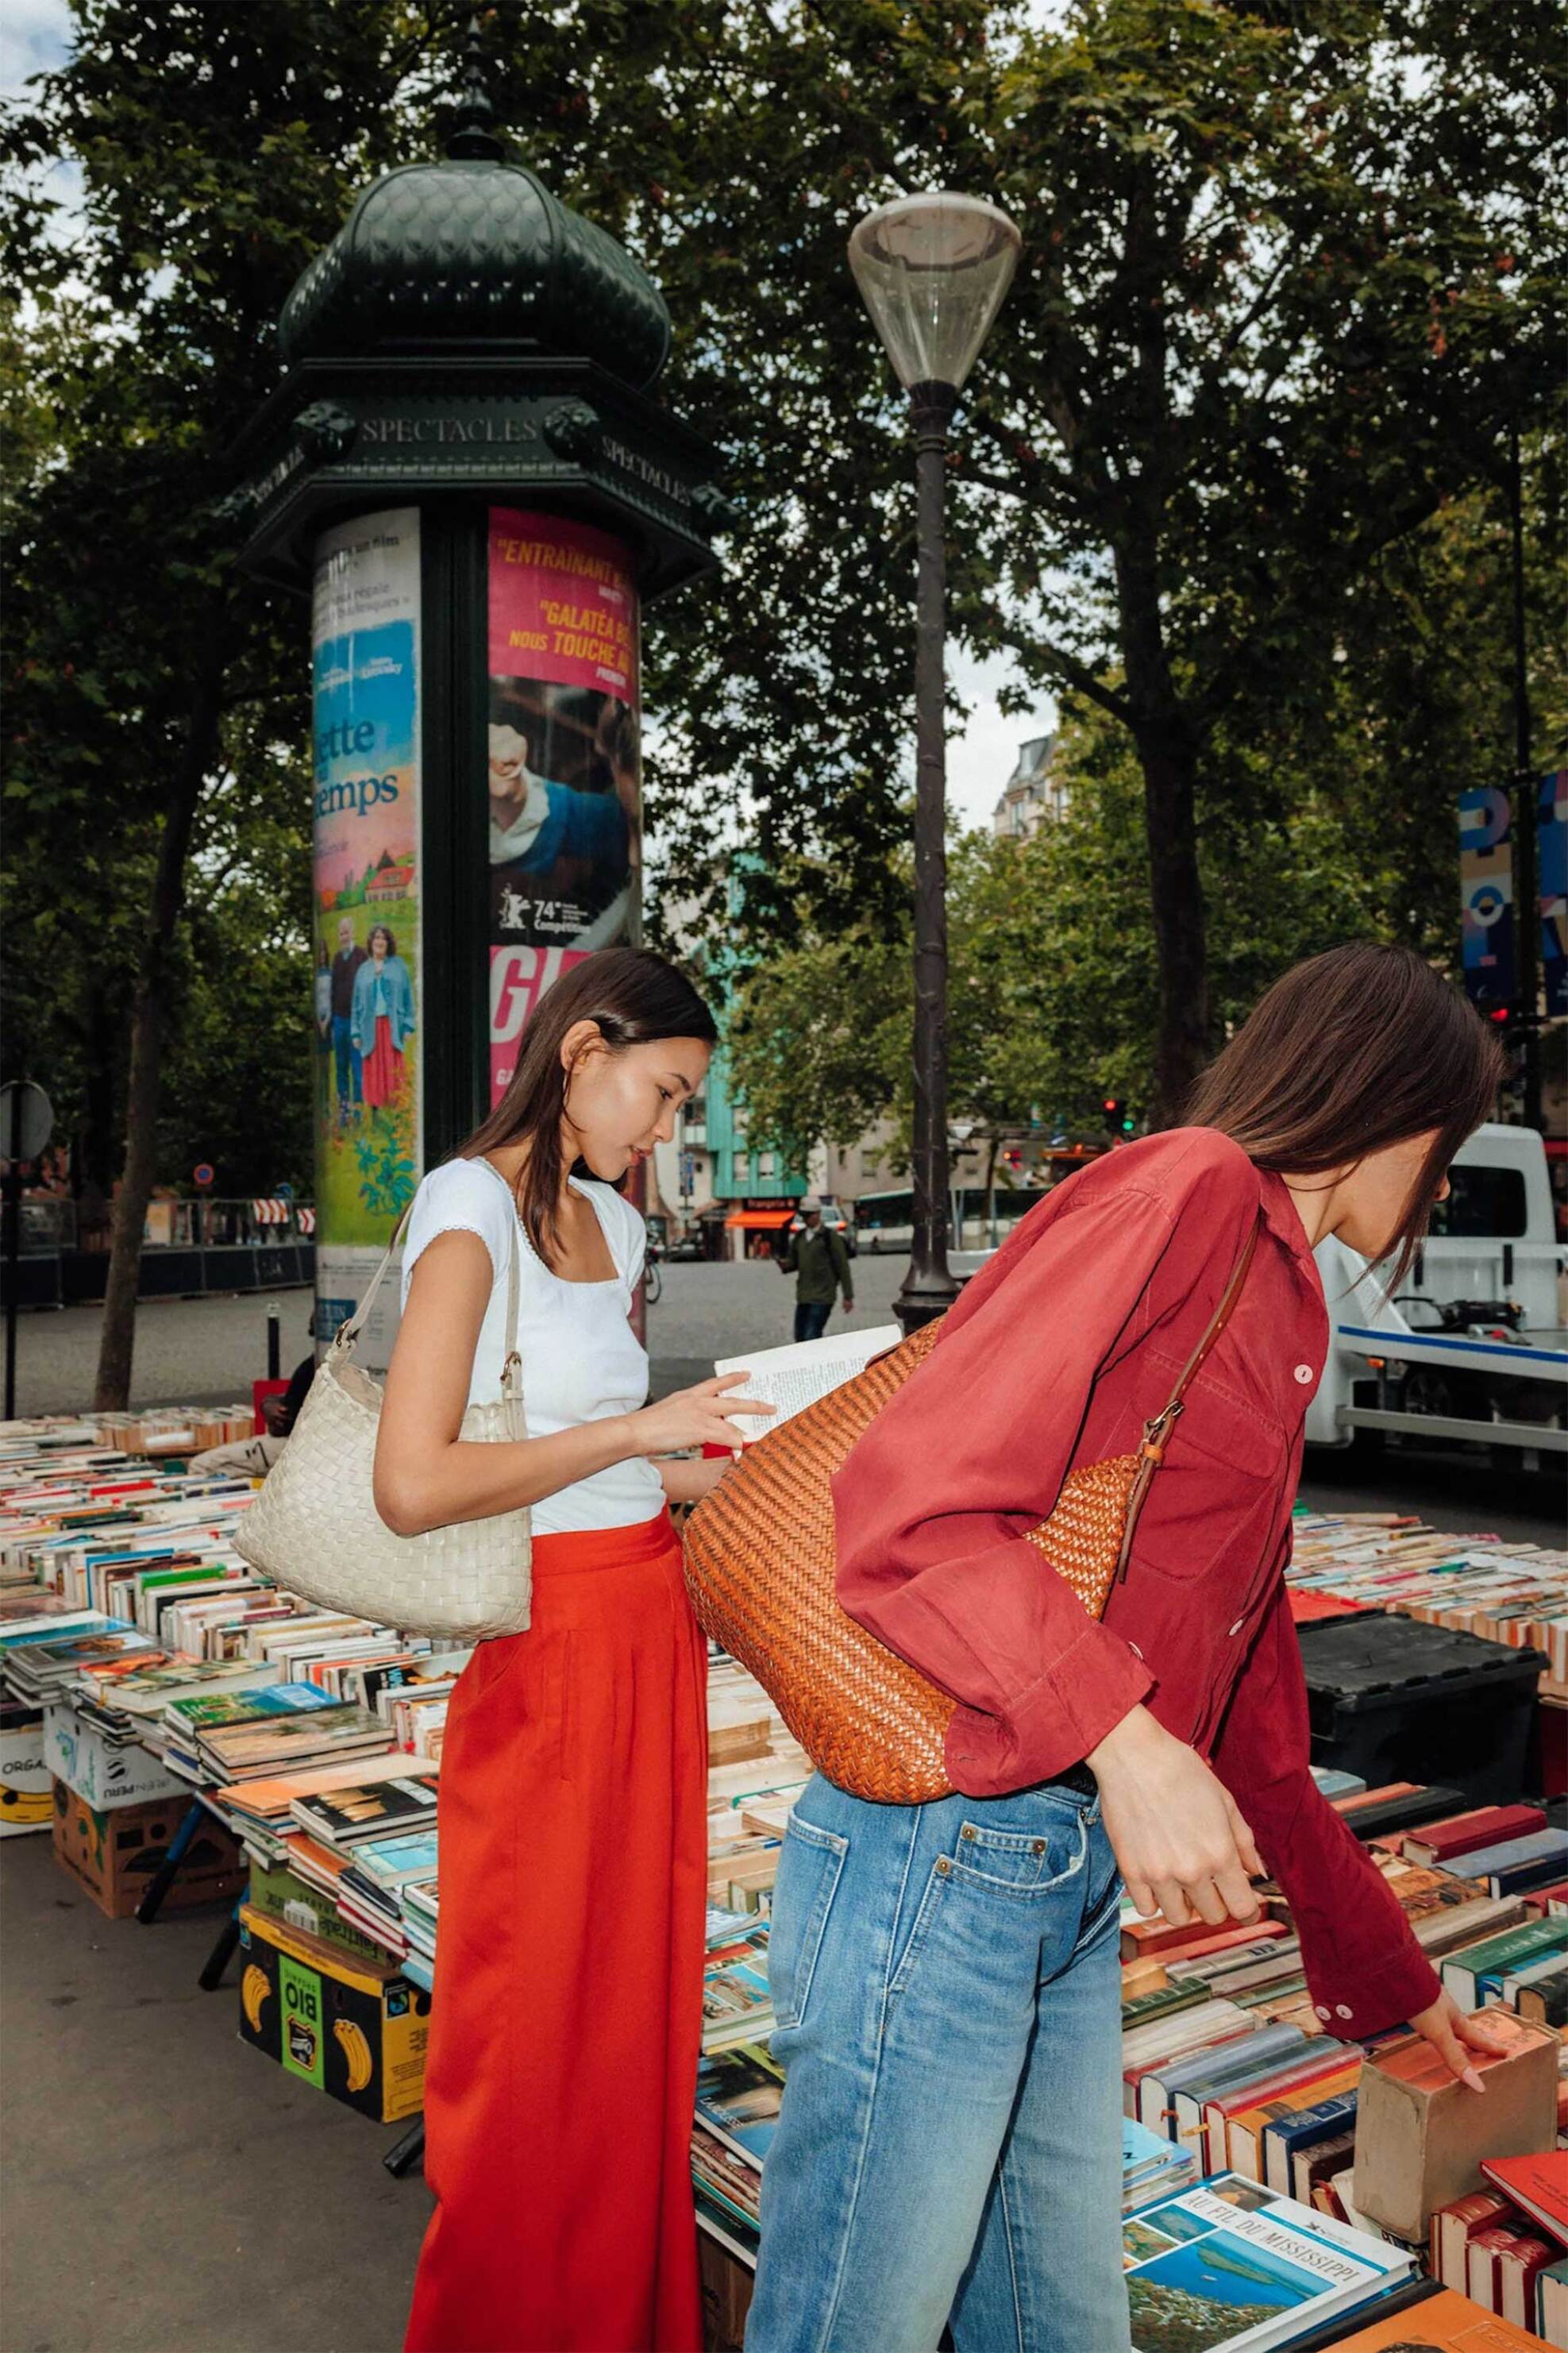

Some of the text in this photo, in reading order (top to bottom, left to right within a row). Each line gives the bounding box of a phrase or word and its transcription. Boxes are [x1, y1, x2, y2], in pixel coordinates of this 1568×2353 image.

[362, 417, 537, 442] SPECTACLES
[509, 630, 549, 651] NOUS
[553, 631, 617, 667] TOUCHE
[2, 1759, 48, 1775] ORGA
[285, 1981, 317, 2022] BIO
[1181, 2194, 1212, 2209] AU
[1208, 2203, 1239, 2224] FIL
[1235, 2220, 1264, 2236] DU
[1260, 2231, 1362, 2282] MISSISSIPPI
